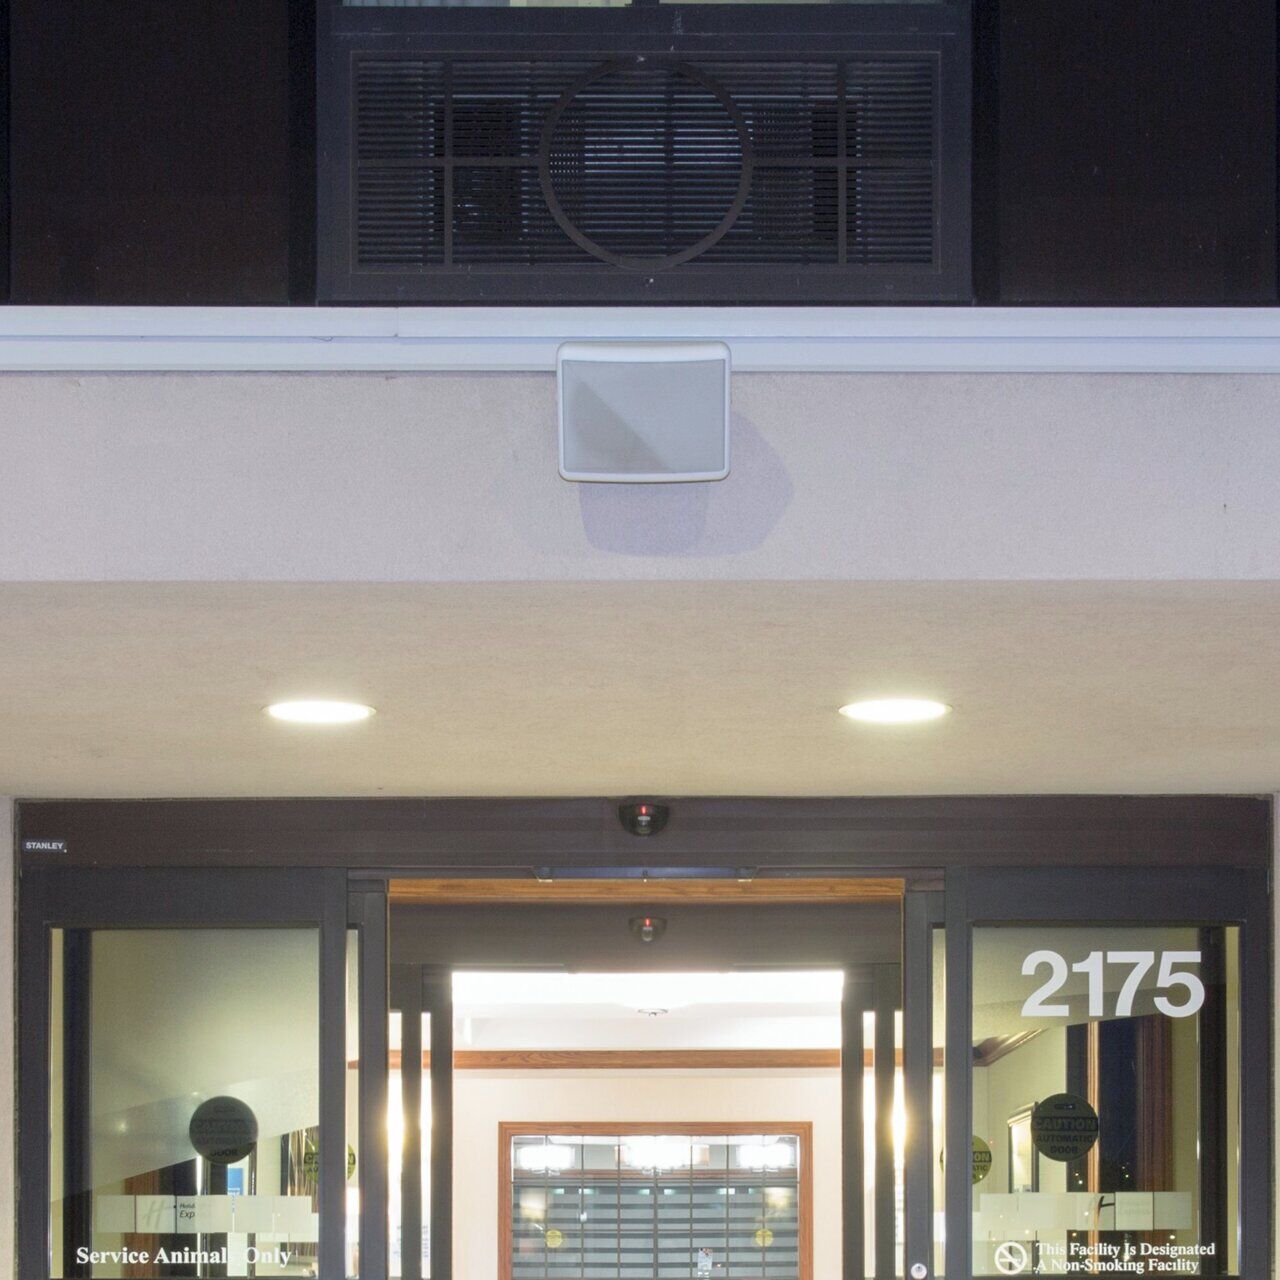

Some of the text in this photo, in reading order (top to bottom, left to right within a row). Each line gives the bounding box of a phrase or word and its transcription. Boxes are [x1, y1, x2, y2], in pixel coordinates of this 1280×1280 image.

[25, 841, 64, 850] STANLEY
[1020, 949, 1206, 1018] 2175
[1031, 1118, 1097, 1130] CAUTION
[1036, 1135, 1094, 1143] AUTOMATIC
[1050, 1146, 1078, 1154] DOOR
[76, 1246, 149, 1264] Service
[244, 1246, 292, 1269] Only
[1035, 1242, 1216, 1259] This Facility Is Designated
[1036, 1259, 1199, 1275] A Non-Smoking Facility
